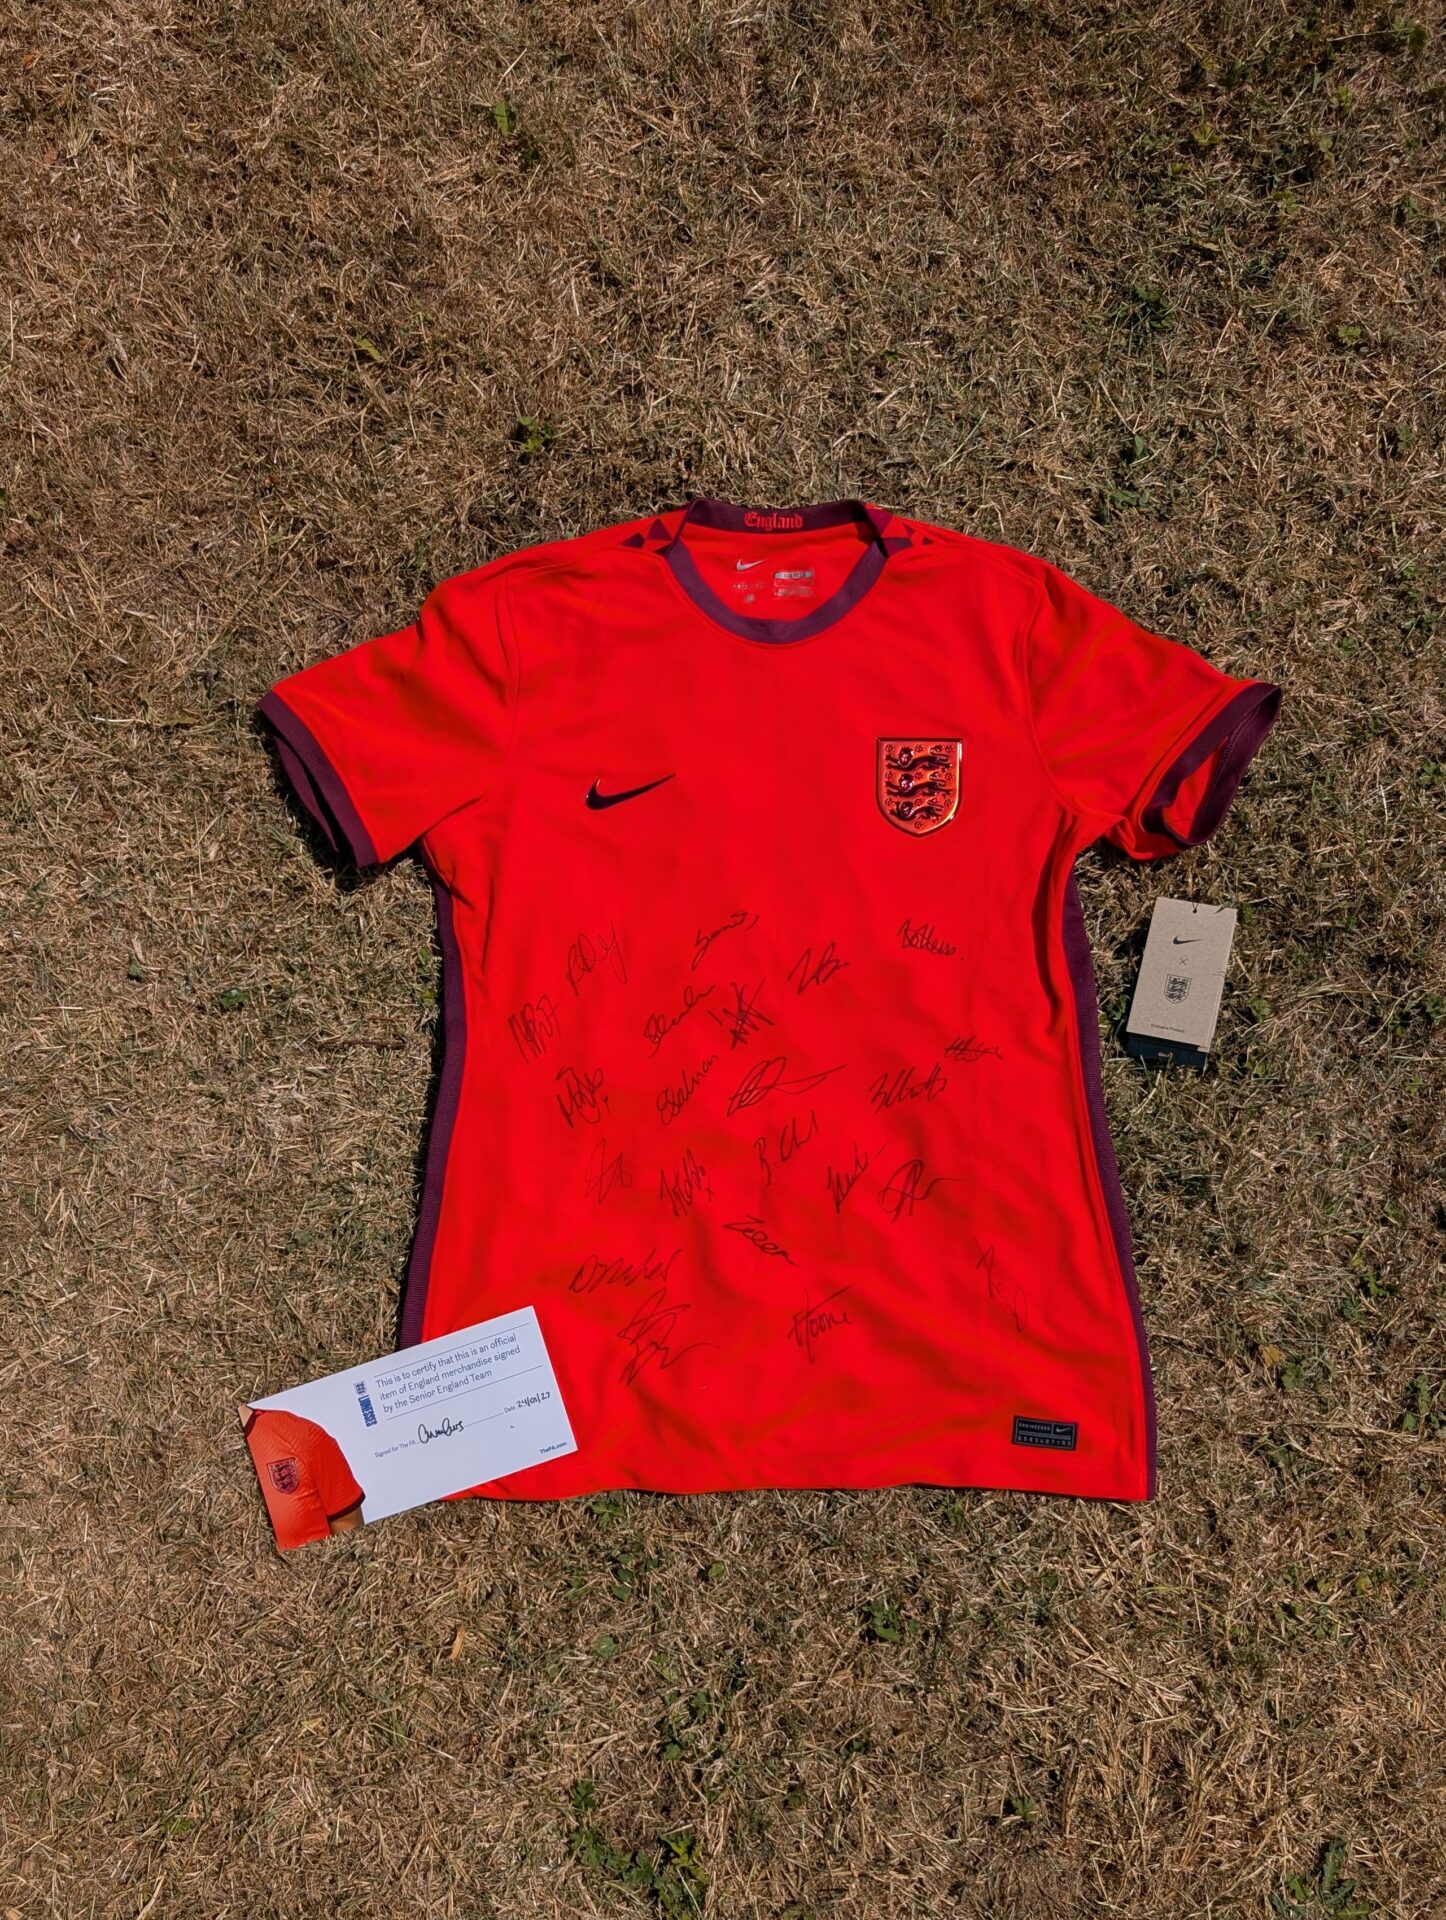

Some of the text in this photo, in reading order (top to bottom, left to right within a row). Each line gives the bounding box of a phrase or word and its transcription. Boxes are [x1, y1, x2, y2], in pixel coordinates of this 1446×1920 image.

[743, 511, 804, 531] England
[375, 1332, 517, 1388] This is to certify that this is an official
[380, 1345, 521, 1401] item of England merchandise signed
[382, 1370, 493, 1413] by the Senior England Team
[358, 1394, 378, 1427] LIONESSES
[503, 1405, 516, 1413] Date
[374, 1448, 392, 1458] Signed
[399, 1442, 409, 1450] The
[539, 1441, 568, 1454] TheFA.com
